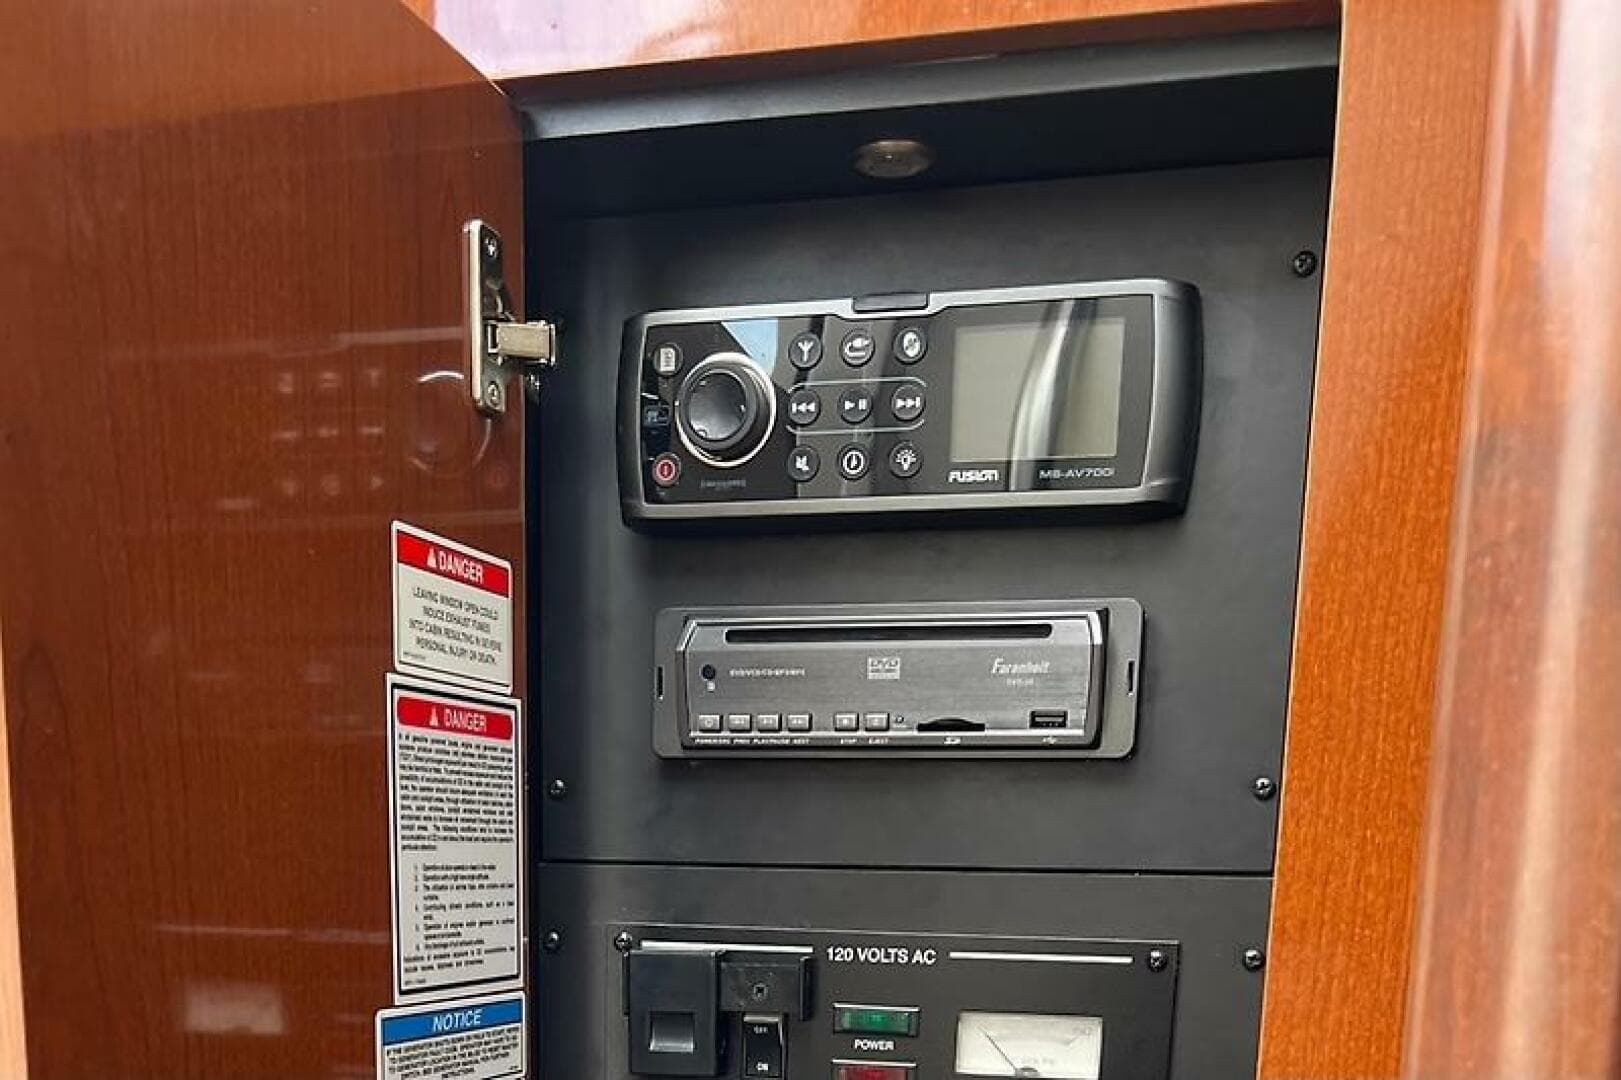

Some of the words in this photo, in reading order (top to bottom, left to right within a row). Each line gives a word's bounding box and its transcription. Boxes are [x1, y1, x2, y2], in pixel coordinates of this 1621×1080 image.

[948, 469, 998, 483] FUSION
[438, 550, 484, 584] DANGER
[444, 708, 487, 733] DANGER
[827, 946, 854, 962] 120
[857, 947, 909, 964] VOLTS
[912, 949, 937, 965] AC
[432, 1009, 484, 1032] NOTICE
[854, 1039, 895, 1051] POWER
